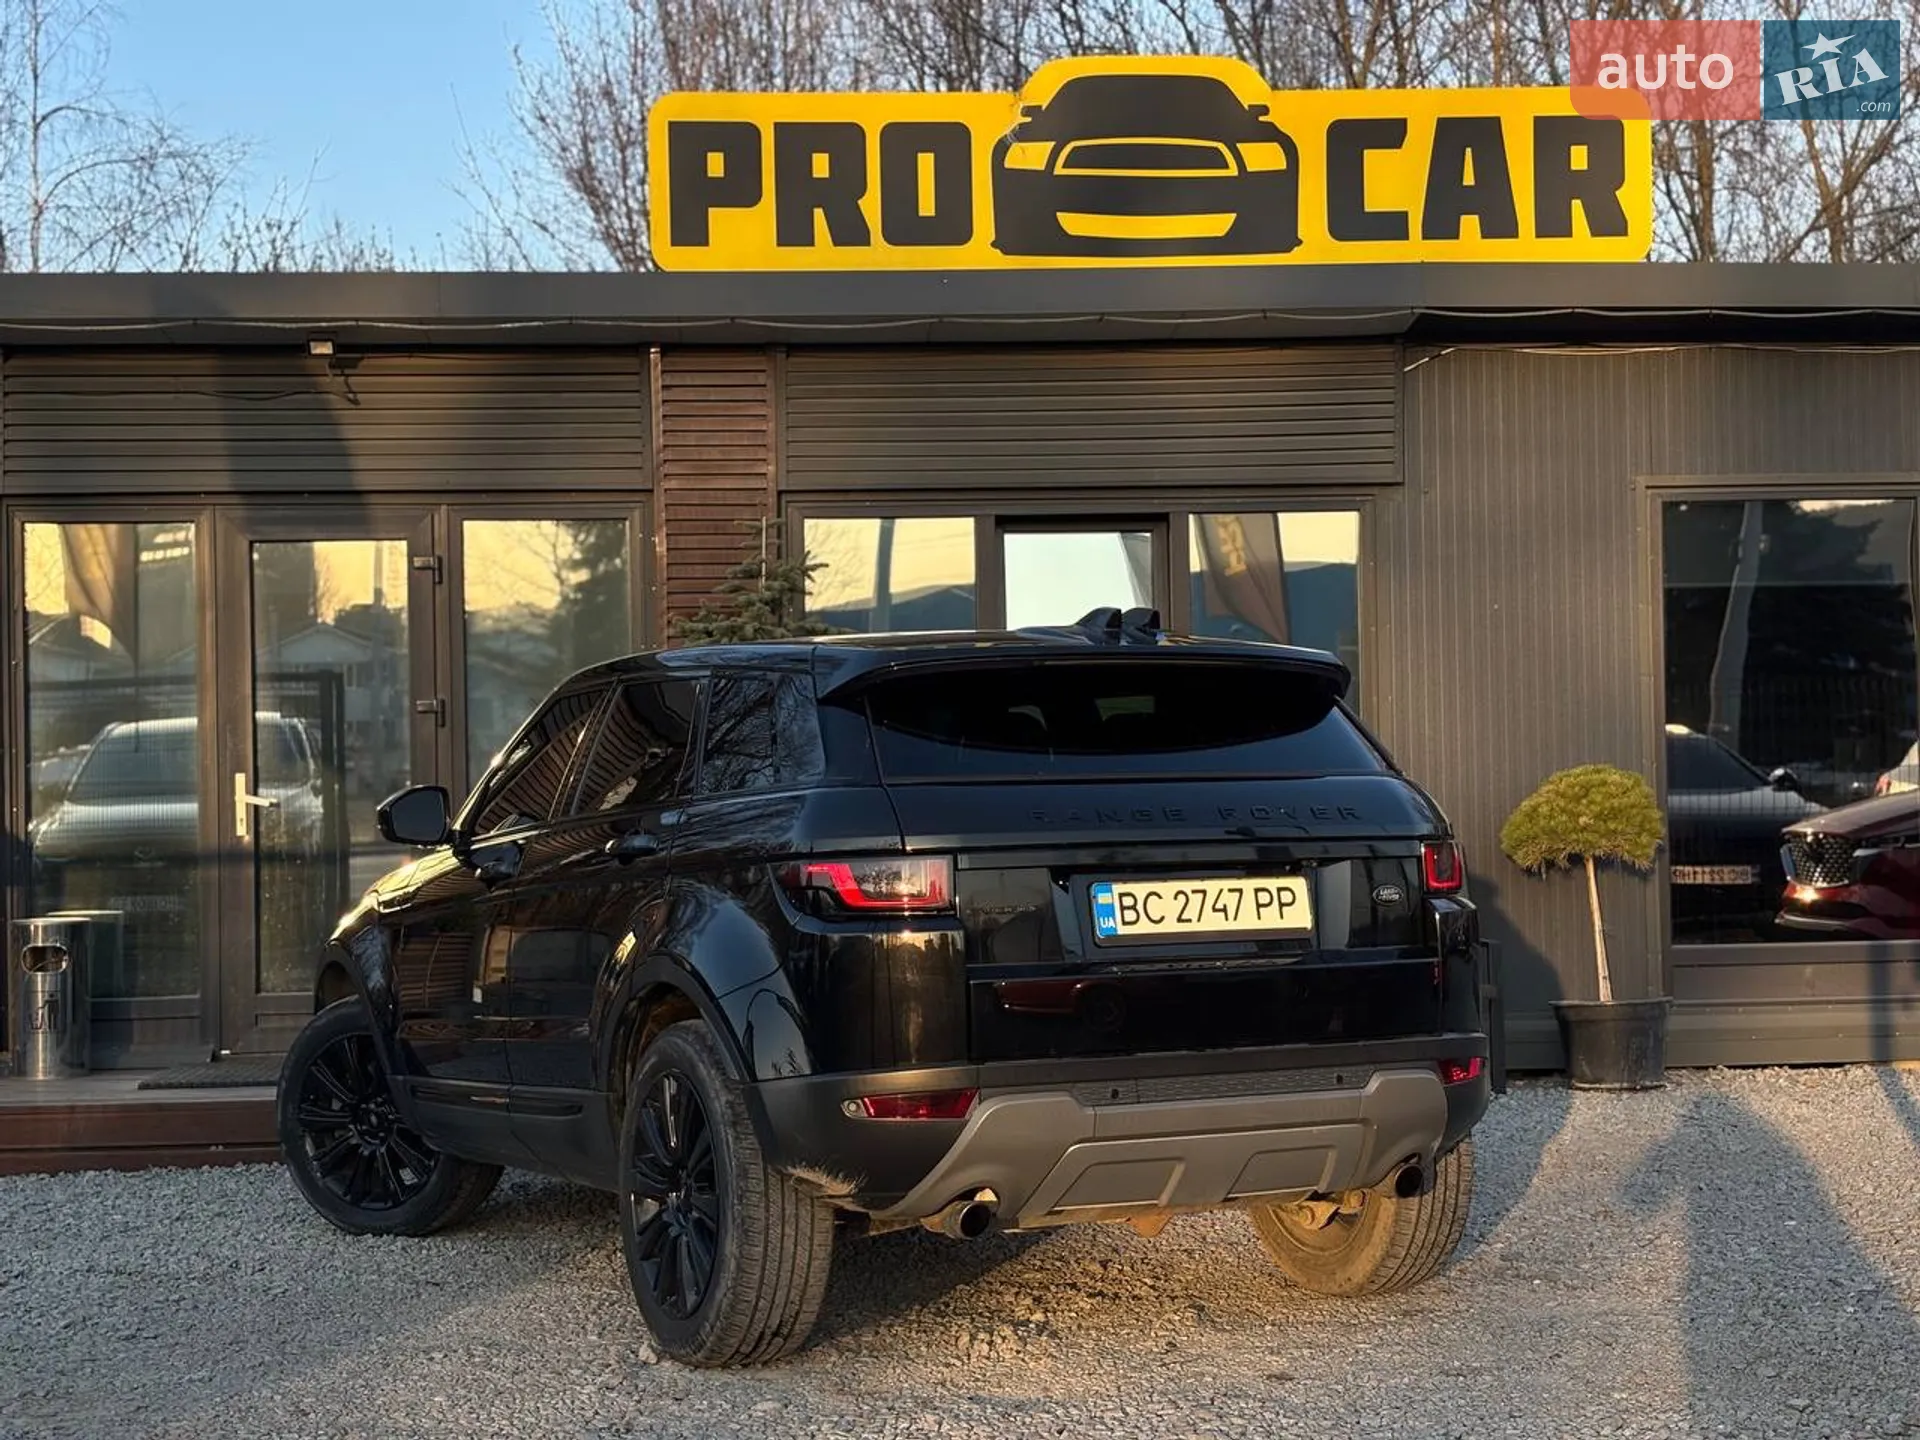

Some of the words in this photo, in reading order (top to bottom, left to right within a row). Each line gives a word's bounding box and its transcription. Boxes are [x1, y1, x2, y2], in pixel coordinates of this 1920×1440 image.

[667, 120, 971, 248] PRO
[1326, 115, 1628, 241] CAR
[1027, 806, 1187, 823] RANGE
[1216, 804, 1362, 821] ROVER
[1118, 890, 1165, 926] BC
[1174, 888, 1243, 923] 2747
[1253, 886, 1296, 920] PP
[1100, 917, 1116, 929] UA
